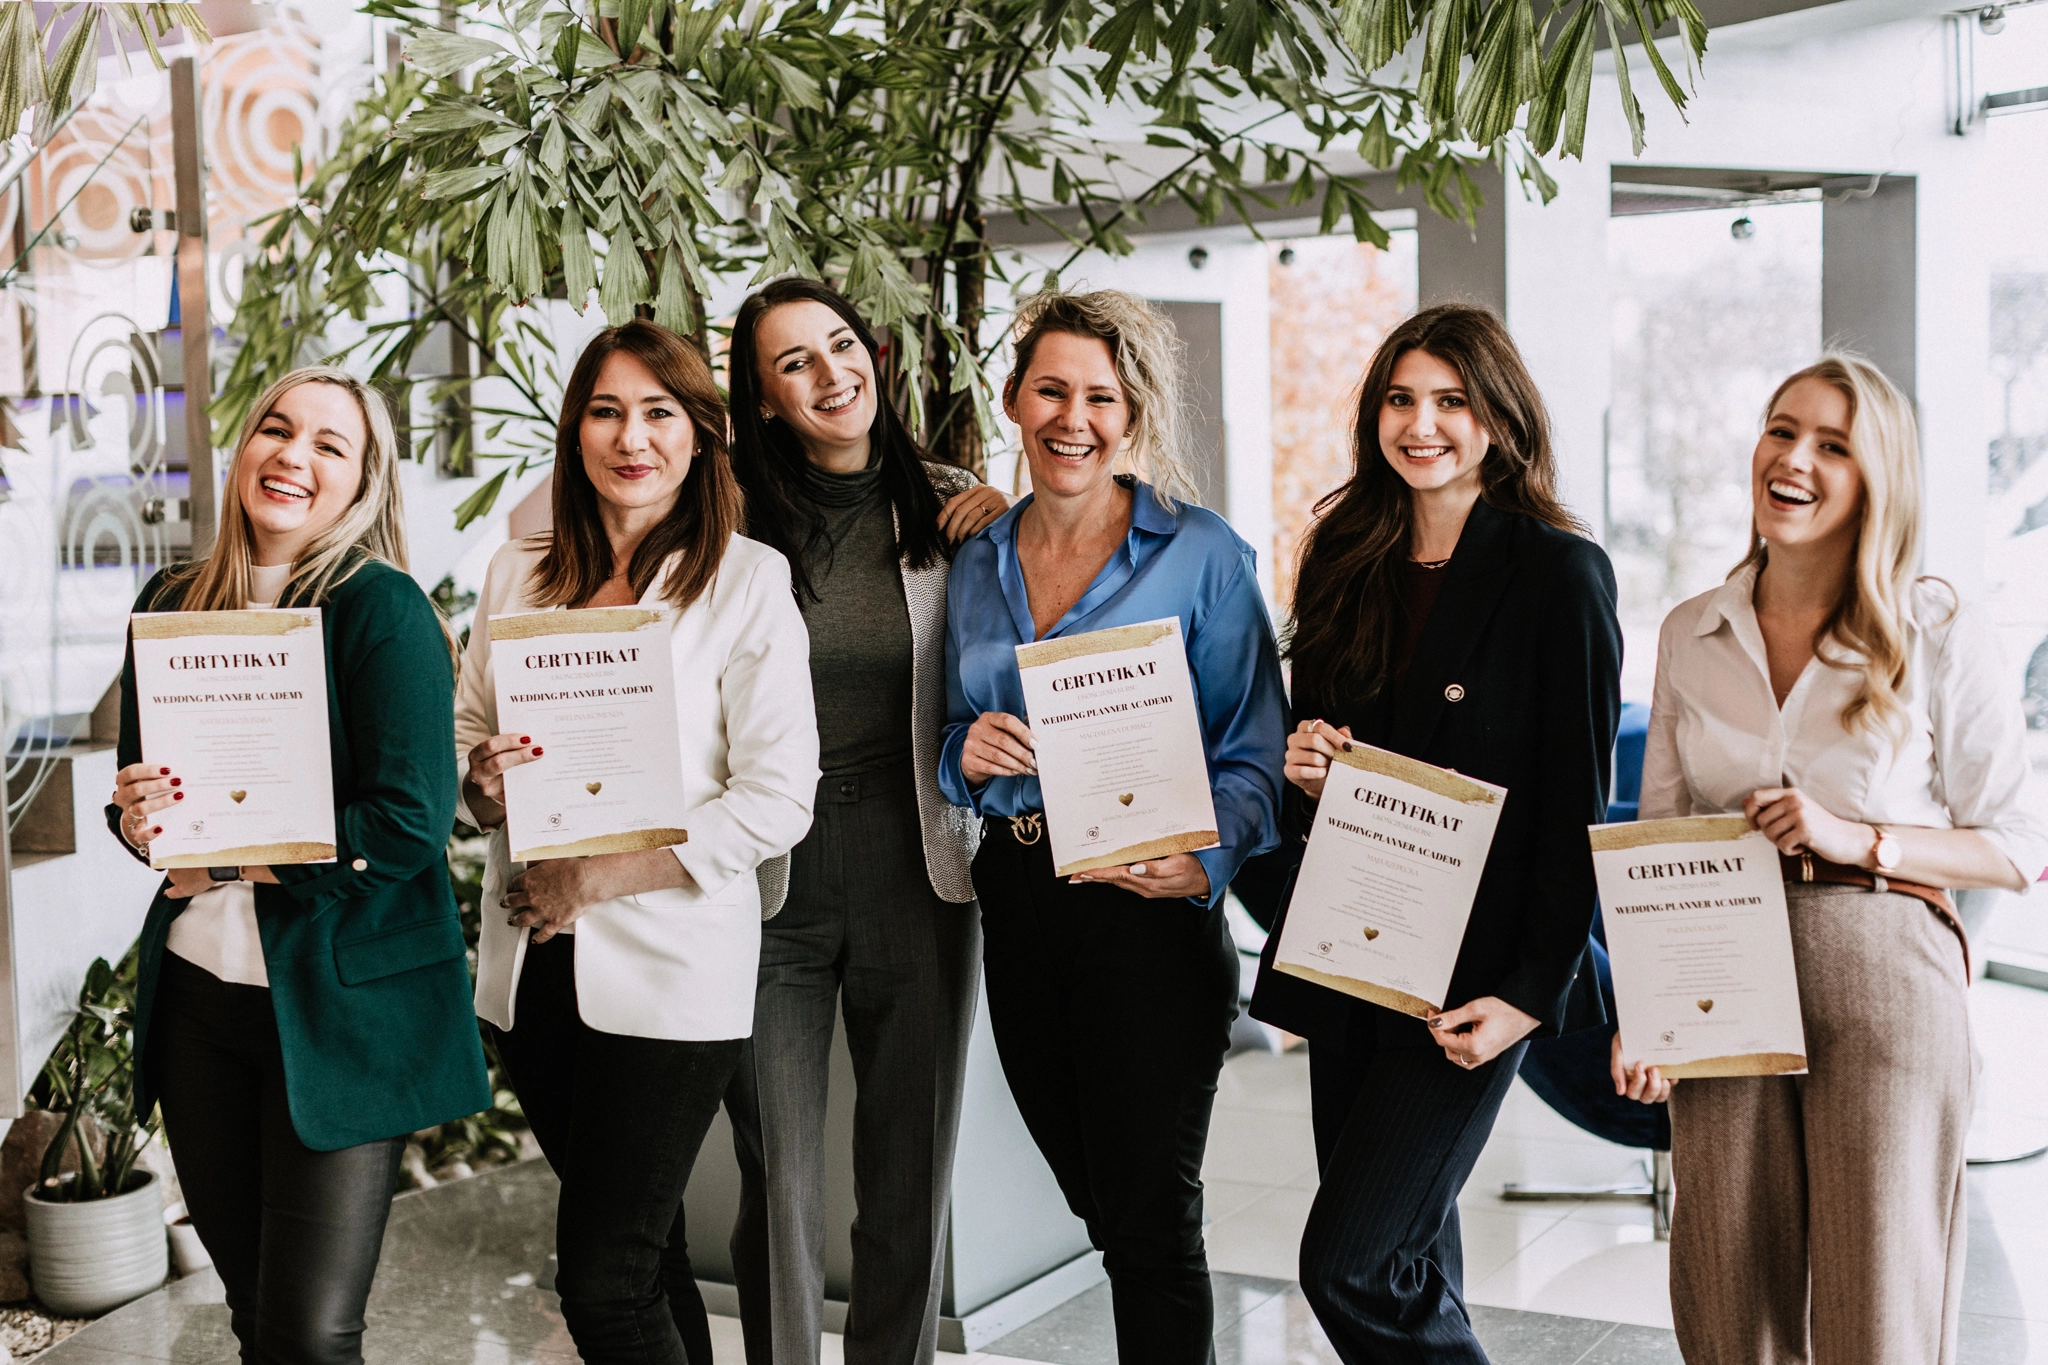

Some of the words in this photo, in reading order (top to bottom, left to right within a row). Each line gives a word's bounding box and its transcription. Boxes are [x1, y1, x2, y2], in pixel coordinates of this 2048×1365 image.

[169, 652, 289, 670] CERTYFIKAT
[525, 648, 640, 669] CERTYFIKAT
[1052, 661, 1156, 692] CERTYFIKAT
[153, 695, 203, 704] WEDDING
[205, 693, 252, 702] PLANNER
[256, 691, 303, 700] ACADEMY
[510, 692, 558, 703] WEDDING
[559, 689, 604, 700] PLANNER
[608, 685, 654, 696] ACADEMY
[1041, 711, 1085, 725] WEDDING
[1086, 703, 1128, 717] PLANNER
[1130, 695, 1173, 709] ACADEMY
[1354, 787, 1463, 832] CERTYFIKAT
[1328, 817, 1372, 838] WEDDING
[1373, 832, 1416, 852] PLANNER
[1416, 847, 1463, 867] ACADEMY
[1628, 857, 1745, 880] CERTYFIKAT
[1615, 904, 1664, 915] WEDDING
[1665, 900, 1712, 911] PLANNER
[1714, 896, 1762, 907] ACADEMY
